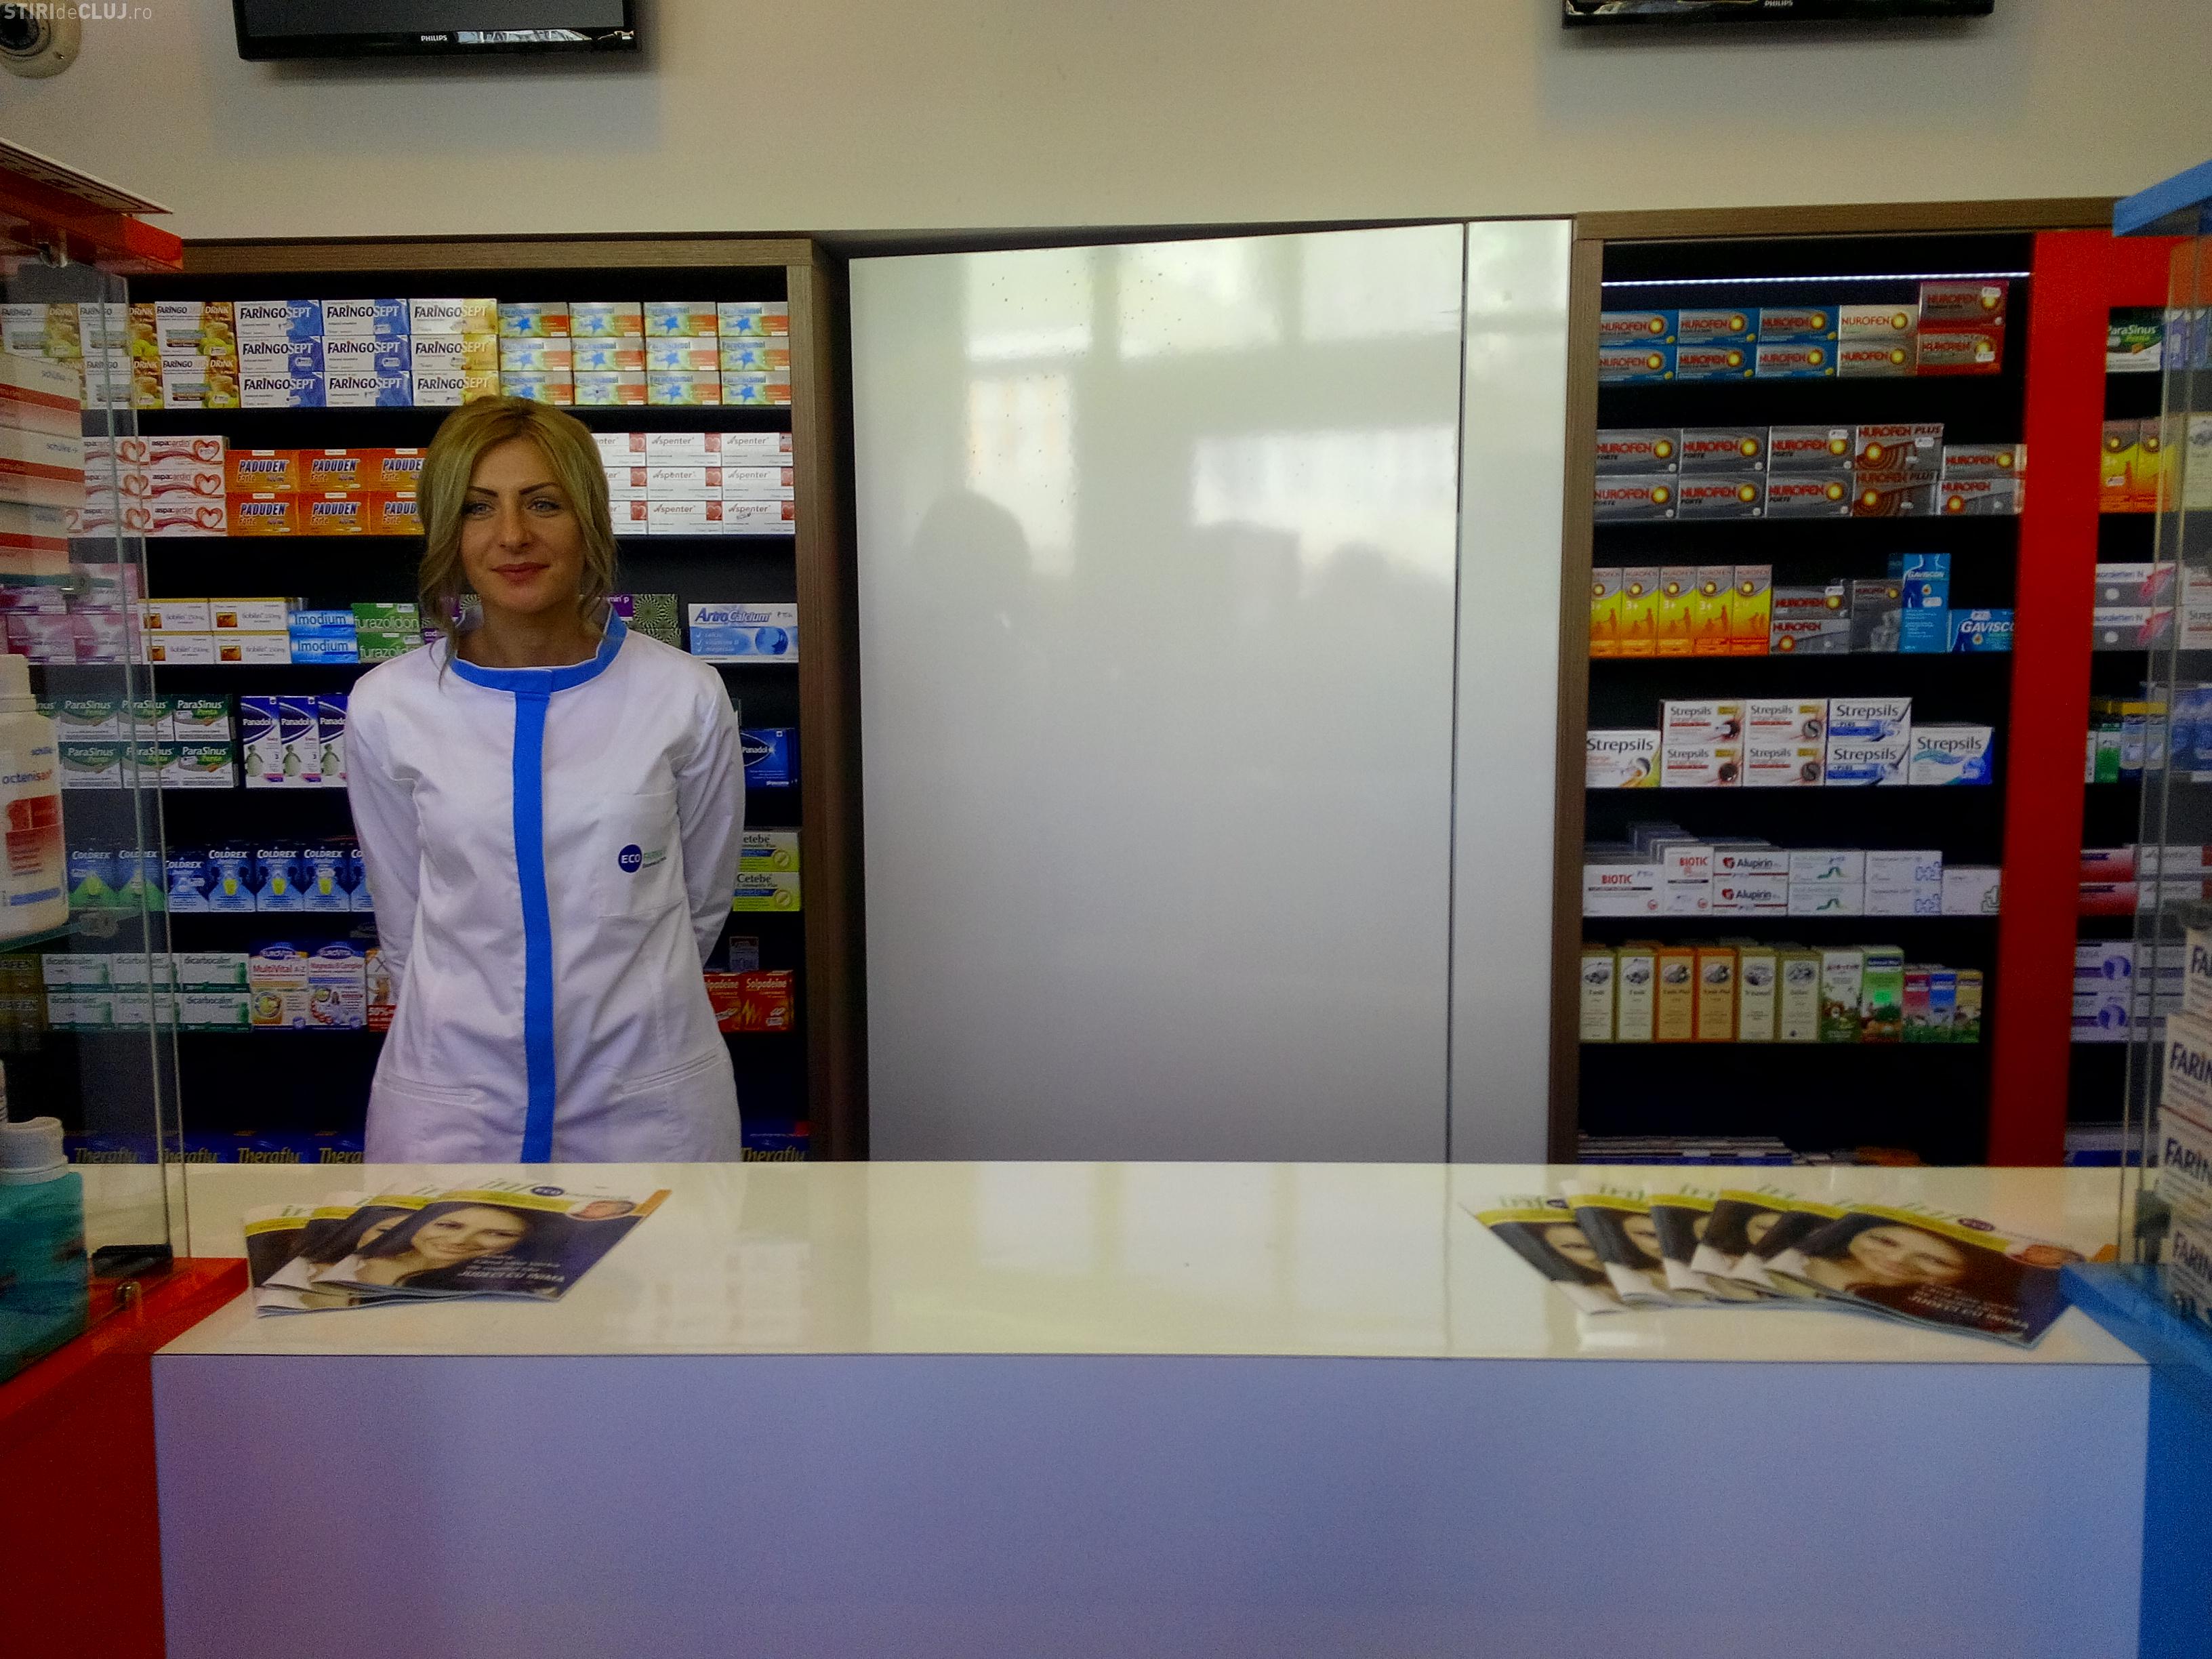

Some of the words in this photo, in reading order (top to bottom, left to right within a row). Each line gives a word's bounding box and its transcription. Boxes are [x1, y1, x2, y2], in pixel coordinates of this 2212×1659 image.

[240, 306, 311, 319] FARINGOSEPT
[327, 305, 400, 319] FARINGOSEPT
[414, 305, 487, 319] FARINGOSEPT
[1842, 316, 1890, 325] NUROFEN
[243, 342, 313, 356] FARINGOSEPT
[327, 341, 401, 354] FARINGOSEPT
[415, 340, 487, 354] FARINGOSEPT
[163, 360, 193, 368] FARINGO
[244, 377, 315, 391] FARINGOSEPT
[329, 377, 403, 390] FARINGOSEPT
[417, 376, 489, 390] FARINGOSEPT
[652, 435, 692, 446] Aspenter
[727, 435, 766, 446] Aspenter
[239, 459, 285, 472] PADUDEN
[312, 459, 356, 472] PADUDEN
[382, 459, 423, 471] PADUDE
[653, 469, 693, 480] Aspenter
[240, 503, 285, 516] PADUDEN
[312, 503, 356, 515] PADUDEN
[653, 504, 693, 514] Aspenter
[295, 614, 346, 625] Imodium
[354, 616, 419, 628] furazolidon
[1961, 621, 2014, 633] GAVISC
[298, 640, 348, 651] Imodium
[65, 701, 111, 709] ParaSinus
[178, 700, 222, 709] ParaSinus
[1671, 706, 1712, 717] Strepsils
[1750, 705, 1793, 716] Strepsils
[1837, 705, 1898, 719] Strepsils
[1586, 738, 1654, 754] Strepsils
[1917, 737, 1982, 752] Strepsils
[68, 748, 113, 756] ParaSinus
[182, 747, 226, 755] ParaSinus
[1667, 749, 1708, 760] Strepsils
[1750, 747, 1791, 759] Strepsils
[1834, 747, 1896, 762] Strepsils
[743, 834, 770, 844] etebe
[73, 851, 111, 860] COLDREX
[119, 849, 157, 859] COLREX
[209, 850, 248, 859] COLDREX
[257, 850, 298, 859] COLDREX
[304, 849, 343, 859] COLDREX
[621, 854, 641, 863] ECO
[1679, 857, 1708, 866] BIOTIC
[1737, 859, 1773, 869] Alupirin
[737, 874, 771, 883] Cetebe
[1602, 875, 1632, 884] BIOTIC
[1736, 890, 1771, 901] Alupirin
[319, 1148, 363, 1164] Thera
